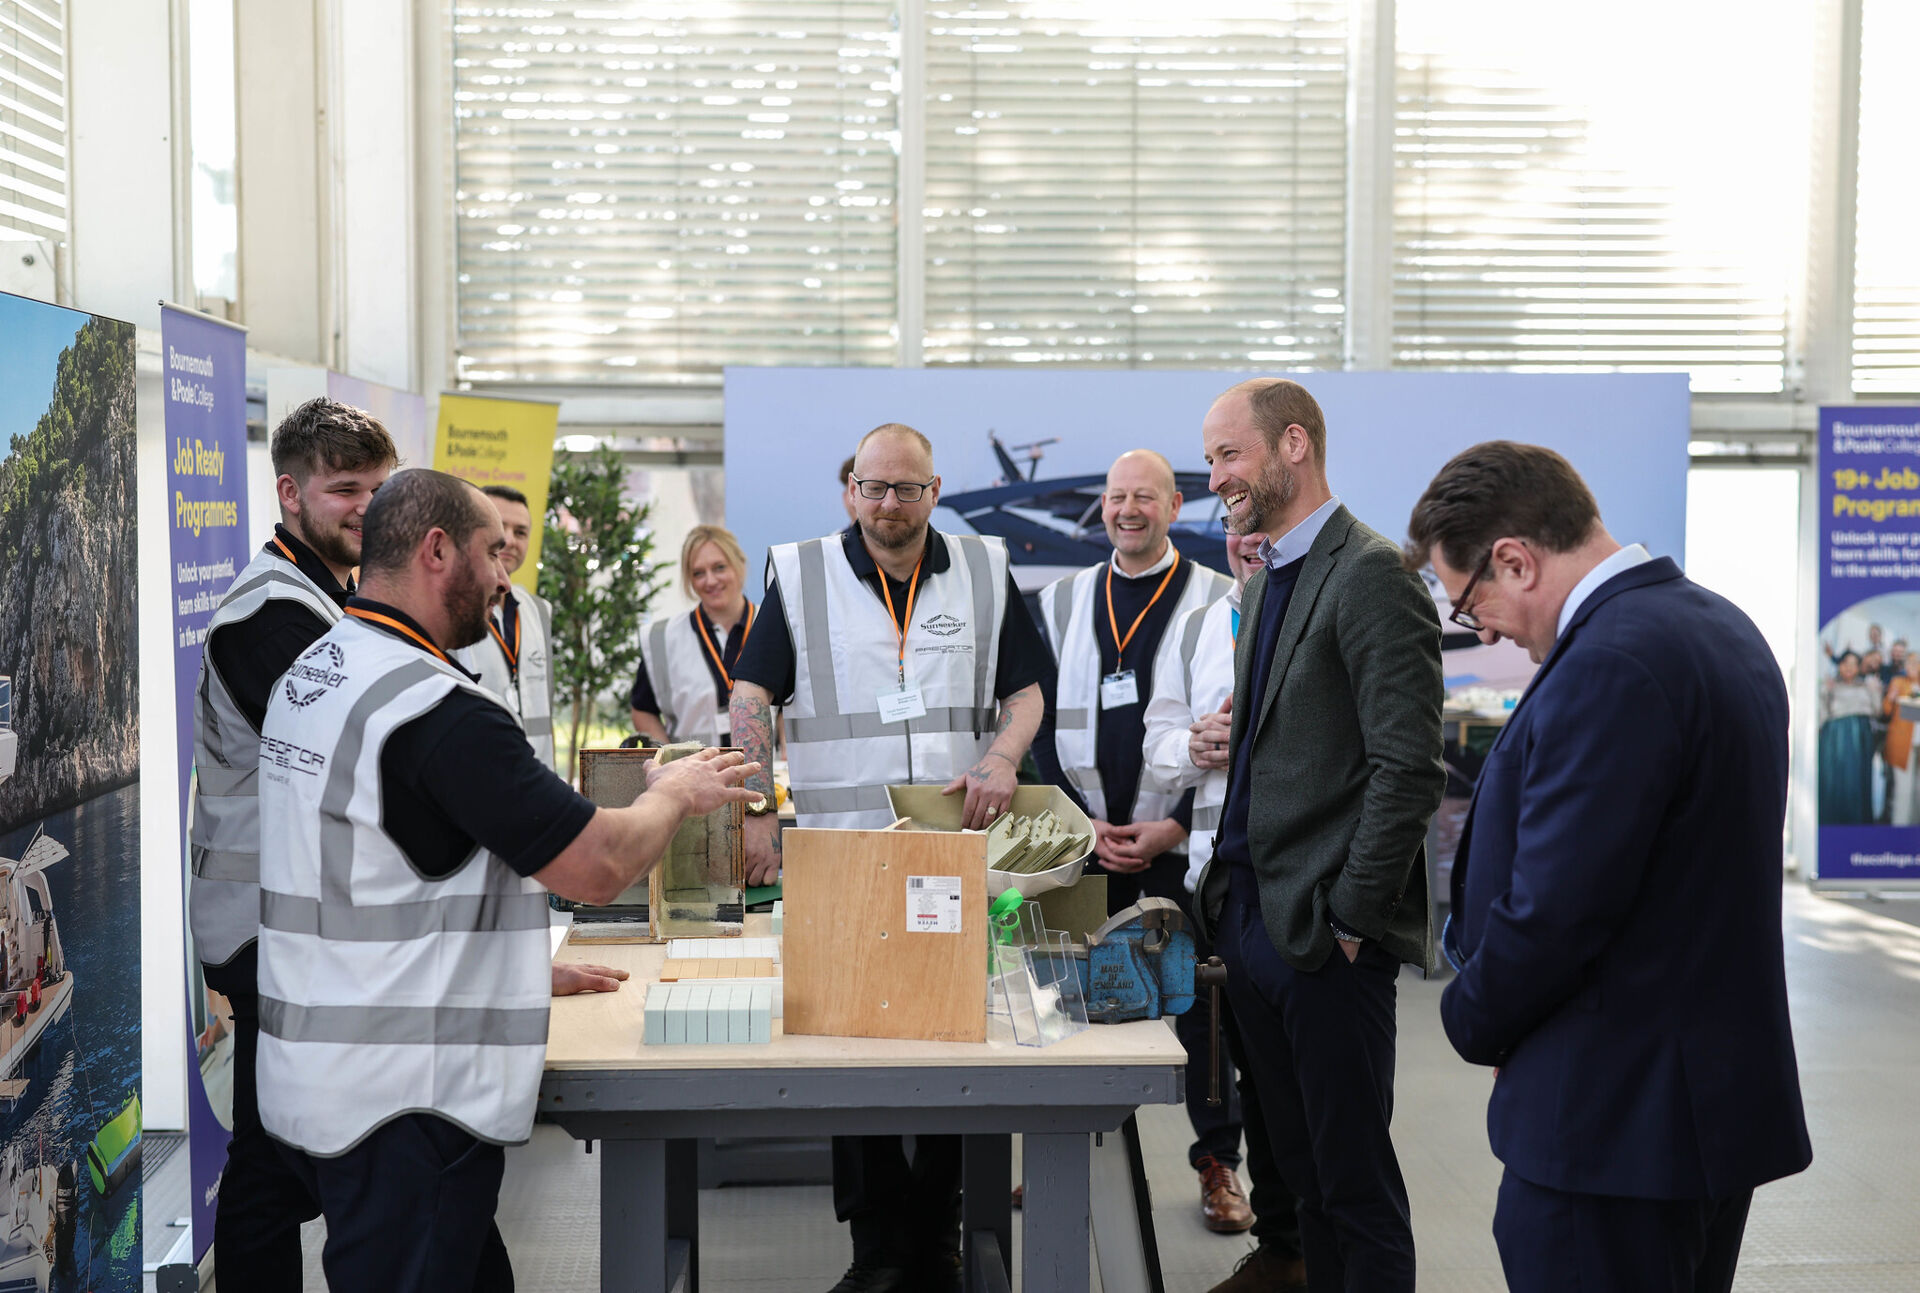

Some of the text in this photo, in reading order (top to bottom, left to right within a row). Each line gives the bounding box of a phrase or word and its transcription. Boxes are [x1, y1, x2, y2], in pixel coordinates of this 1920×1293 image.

[170, 345, 214, 378] Bournemouth
[174, 436, 225, 486] Job Ready
[1873, 466, 1920, 491] Job
[175, 490, 239, 538] Programmes
[177, 560, 198, 584] Unlock
[198, 565, 212, 586] your
[178, 594, 194, 616] learn
[193, 590, 210, 613] skills
[179, 626, 186, 648] in
[185, 624, 196, 647] the
[920, 621, 967, 630] Sunseeker
[1101, 963, 1125, 974] MADE
[1108, 973, 1118, 981] IN
[1094, 980, 1134, 990] ENGLAND
